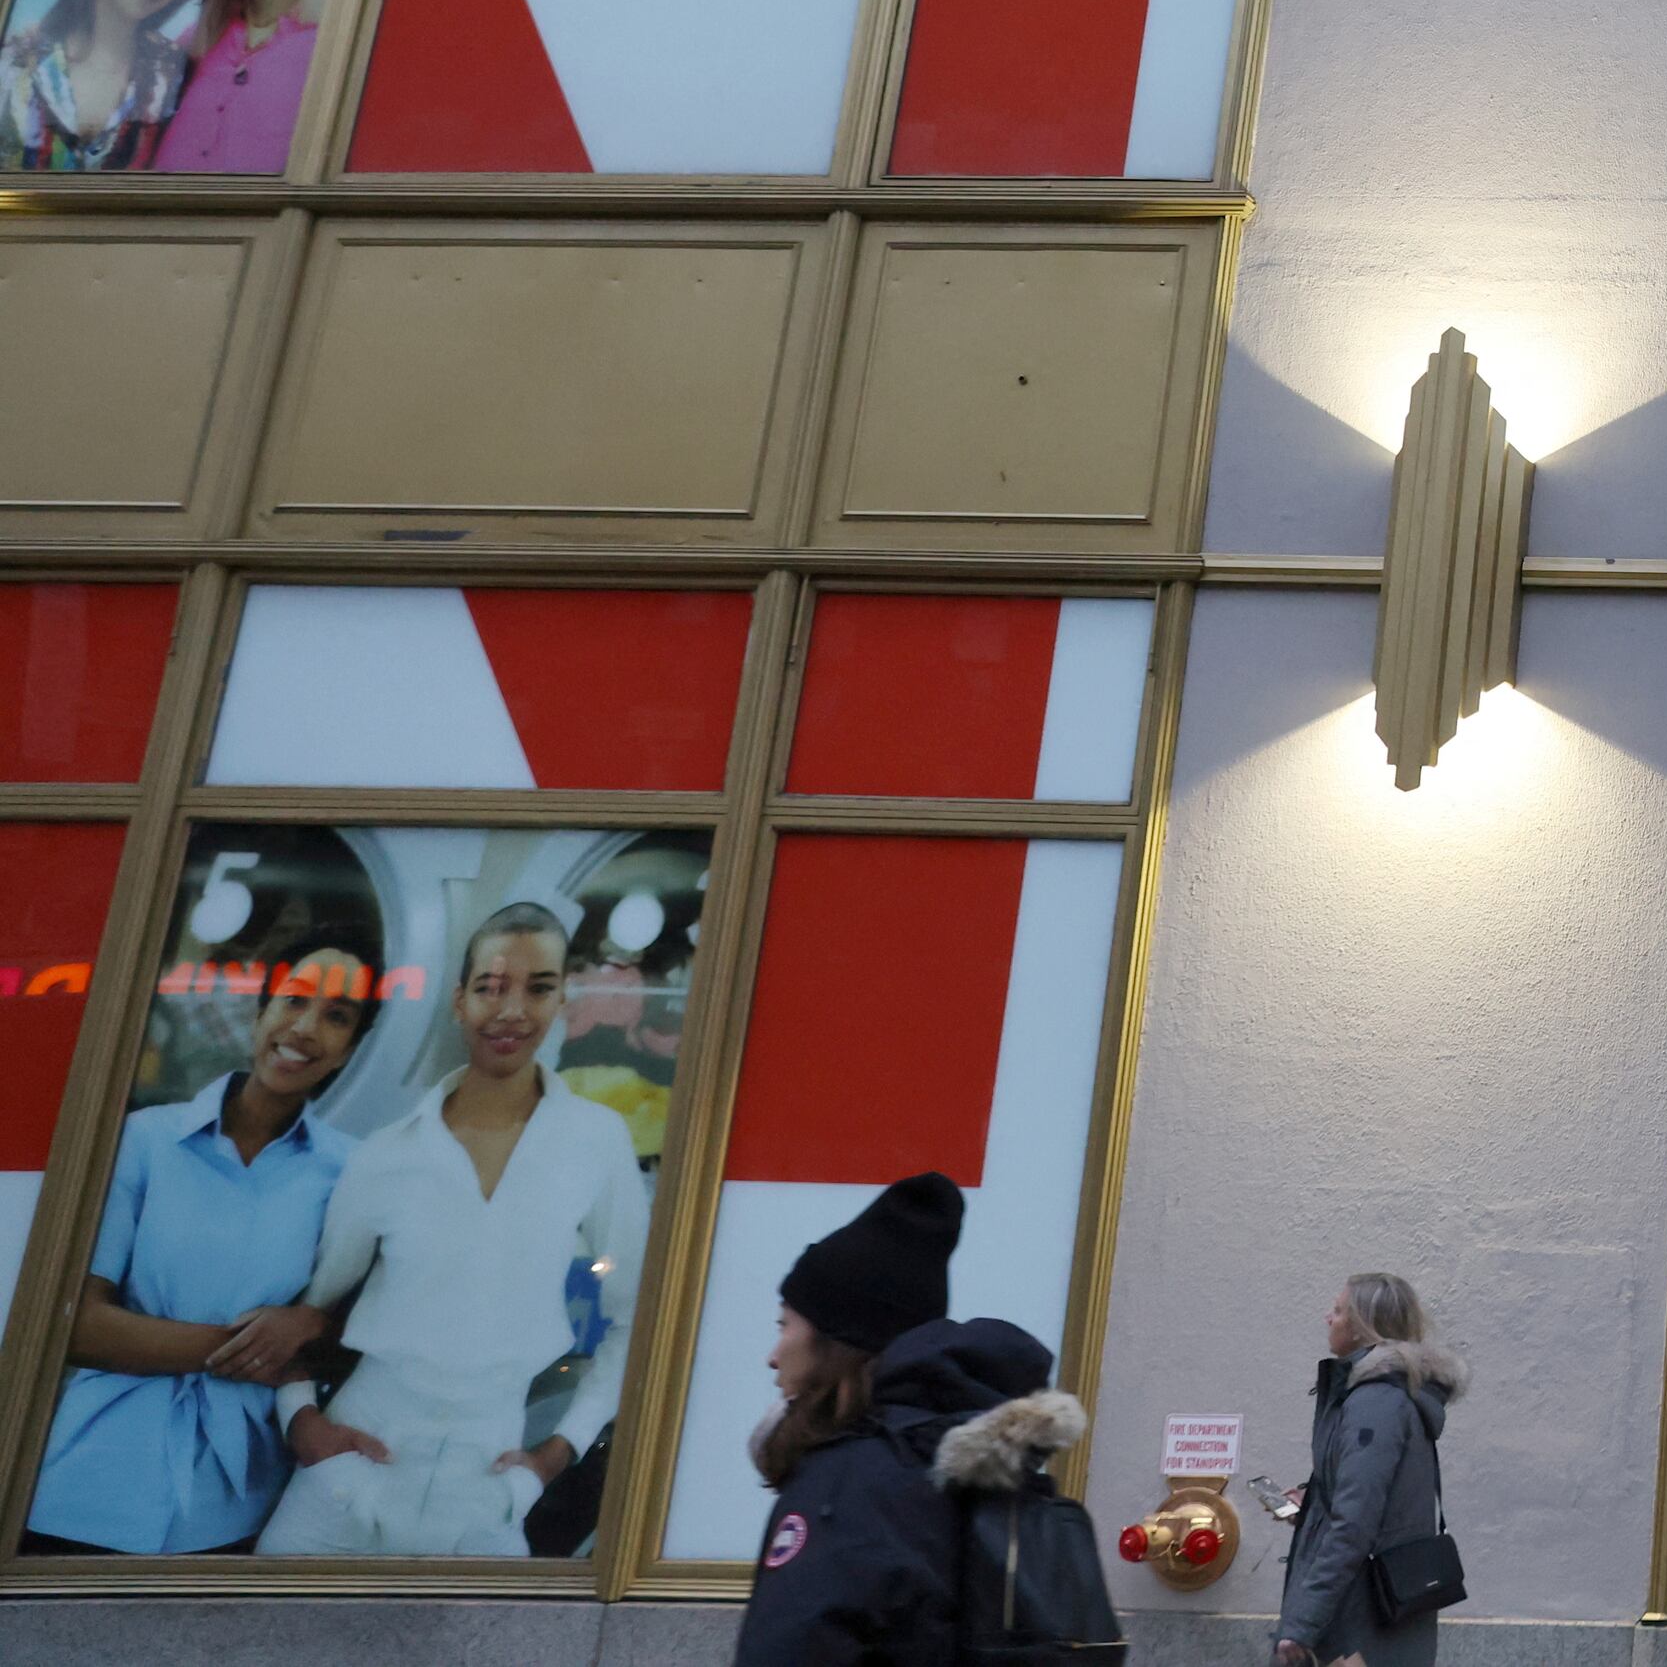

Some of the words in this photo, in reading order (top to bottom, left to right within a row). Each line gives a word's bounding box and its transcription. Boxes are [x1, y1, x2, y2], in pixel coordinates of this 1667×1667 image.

[1170, 1424, 1185, 1435] FIRE
[1188, 1424, 1236, 1435] DEPARTMENT
[1176, 1441, 1228, 1452] CONNECTION
[1167, 1457, 1183, 1468] FOR
[1187, 1457, 1233, 1468] STANDPIPE
